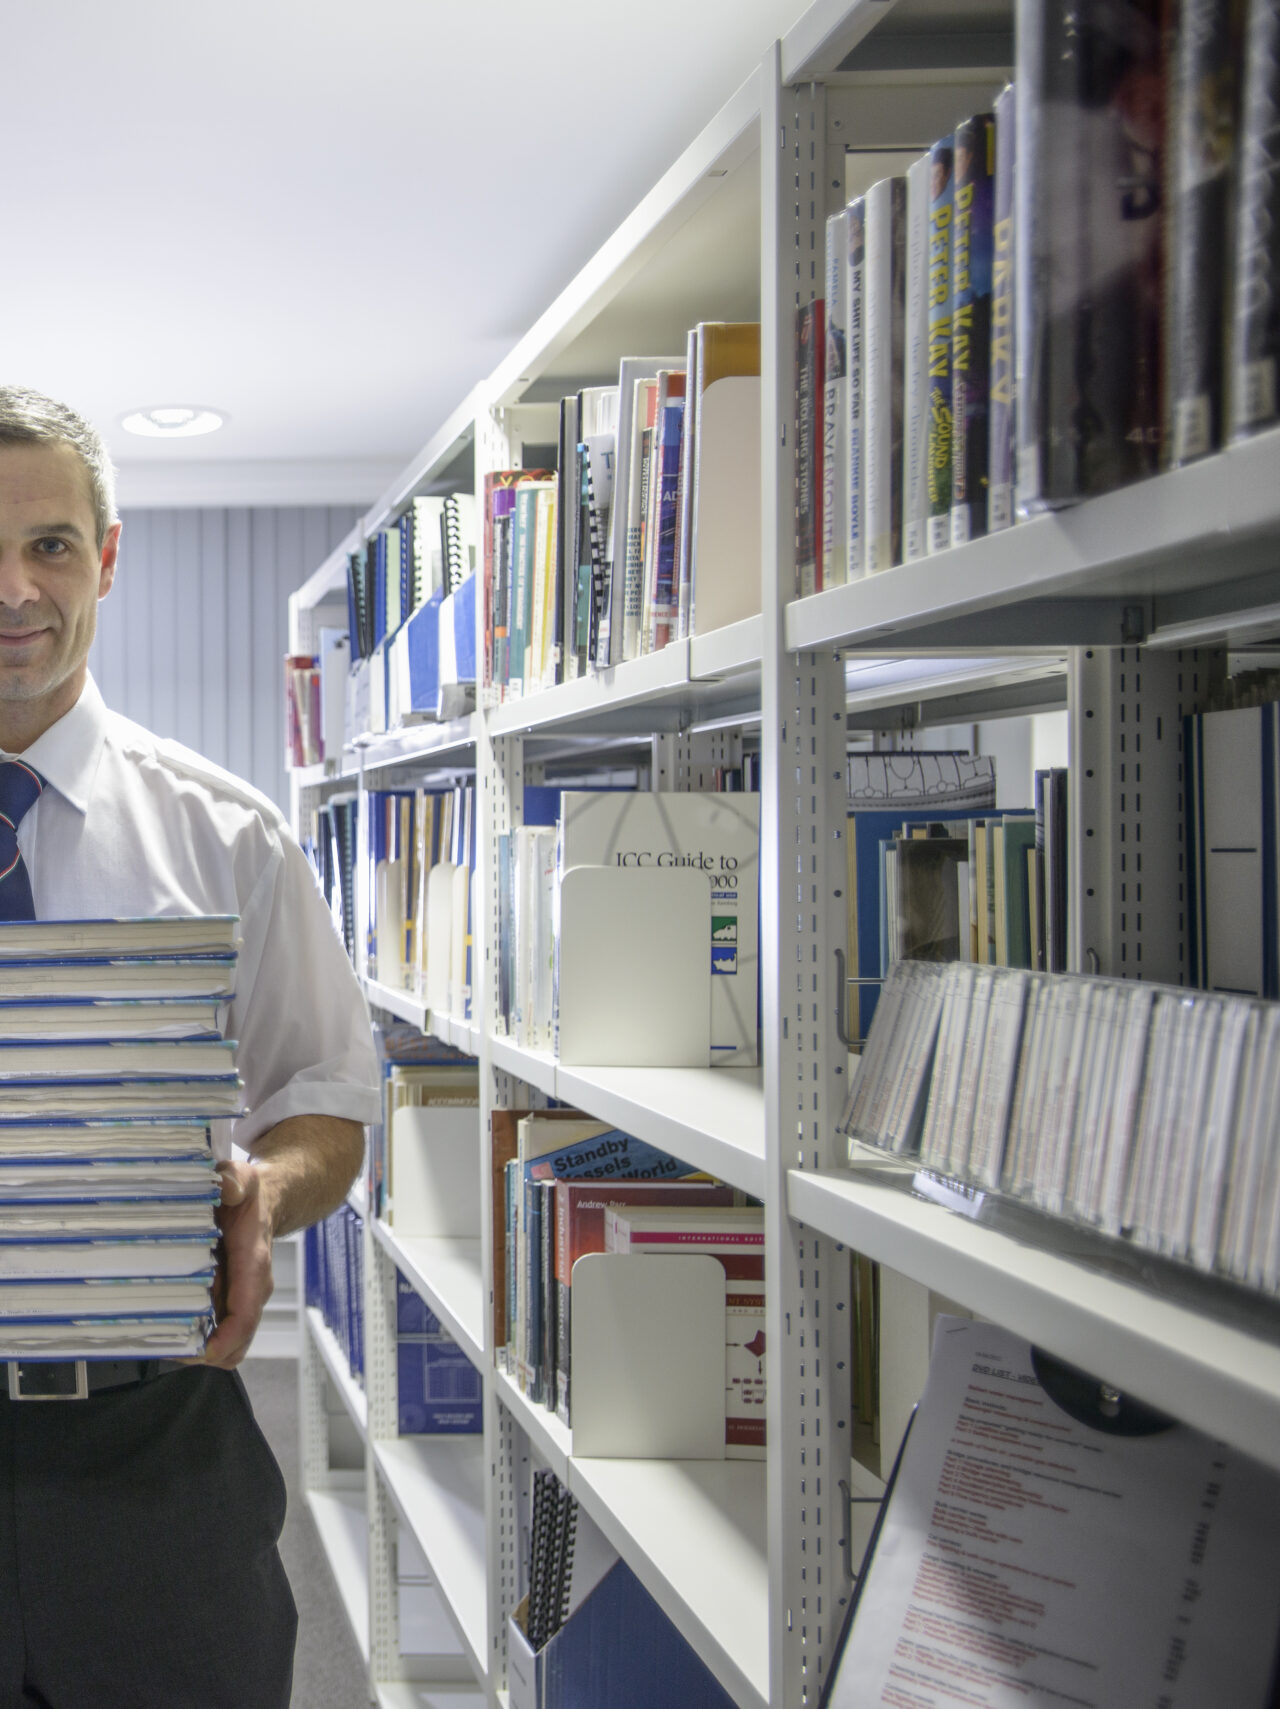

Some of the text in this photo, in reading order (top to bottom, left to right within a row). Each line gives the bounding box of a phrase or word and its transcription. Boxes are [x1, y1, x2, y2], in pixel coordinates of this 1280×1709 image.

[954, 184, 973, 294] PETER
[852, 269, 861, 293] MY
[928, 203, 950, 377] PETER KAY
[852, 297, 861, 334] SHIT
[852, 336, 860, 371] LIFE
[952, 303, 970, 371] KAY
[852, 375, 860, 396] SO
[852, 397, 860, 421] FAR
[931, 407, 952, 468] SOUND
[823, 386, 835, 554] BRAVEMOUTH
[851, 493, 859, 541] BOYLE
[617, 852, 738, 870] ICC Guide to
[554, 1137, 629, 1173] Standby
[567, 1155, 631, 1179] essels
[621, 1158, 678, 1179] World
[577, 1200, 607, 1209] Andrew
